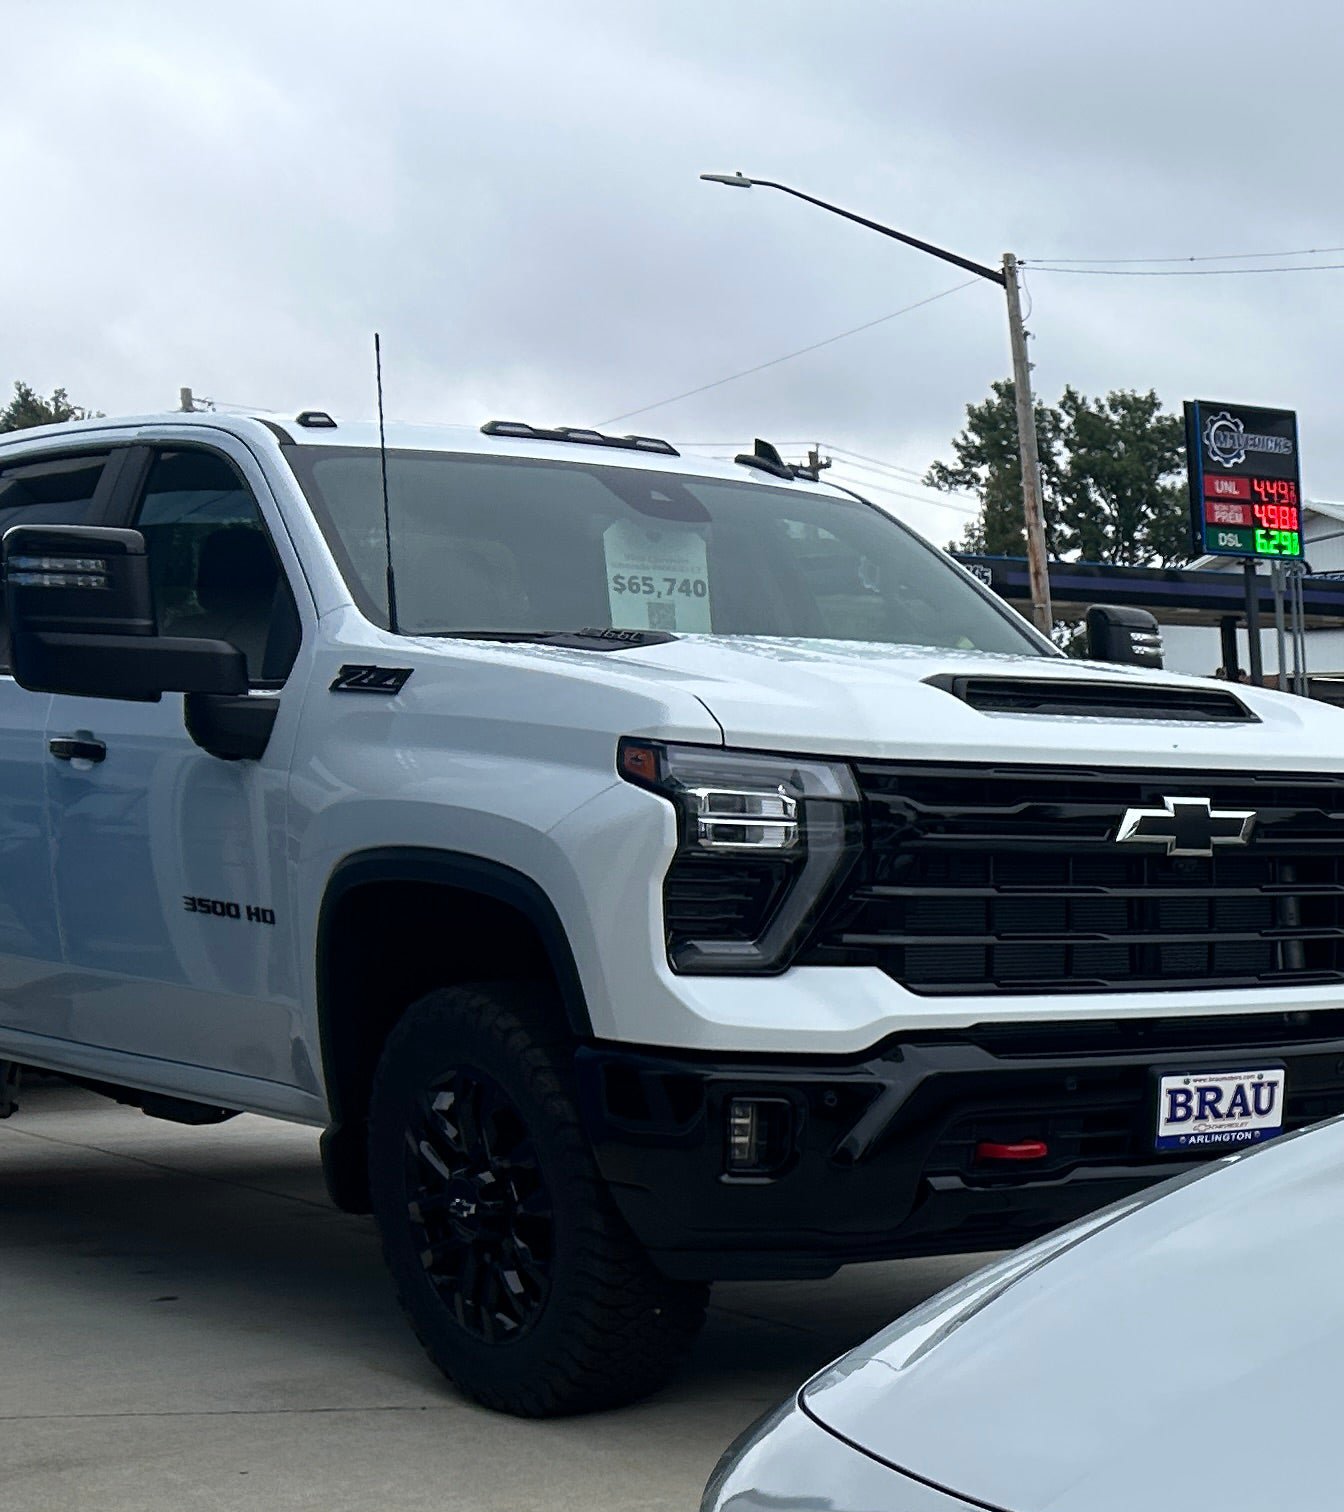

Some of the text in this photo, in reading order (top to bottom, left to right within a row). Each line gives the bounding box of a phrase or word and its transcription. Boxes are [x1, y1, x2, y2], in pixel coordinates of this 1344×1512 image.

[1214, 479, 1240, 495] UNL
[1218, 532, 1242, 547] DSL
[611, 573, 707, 598] $65,740
[182, 895, 276, 925] 3500 HD
[1164, 1081, 1280, 1125] BRAU
[1188, 1131, 1252, 1144] ARLINGTON
